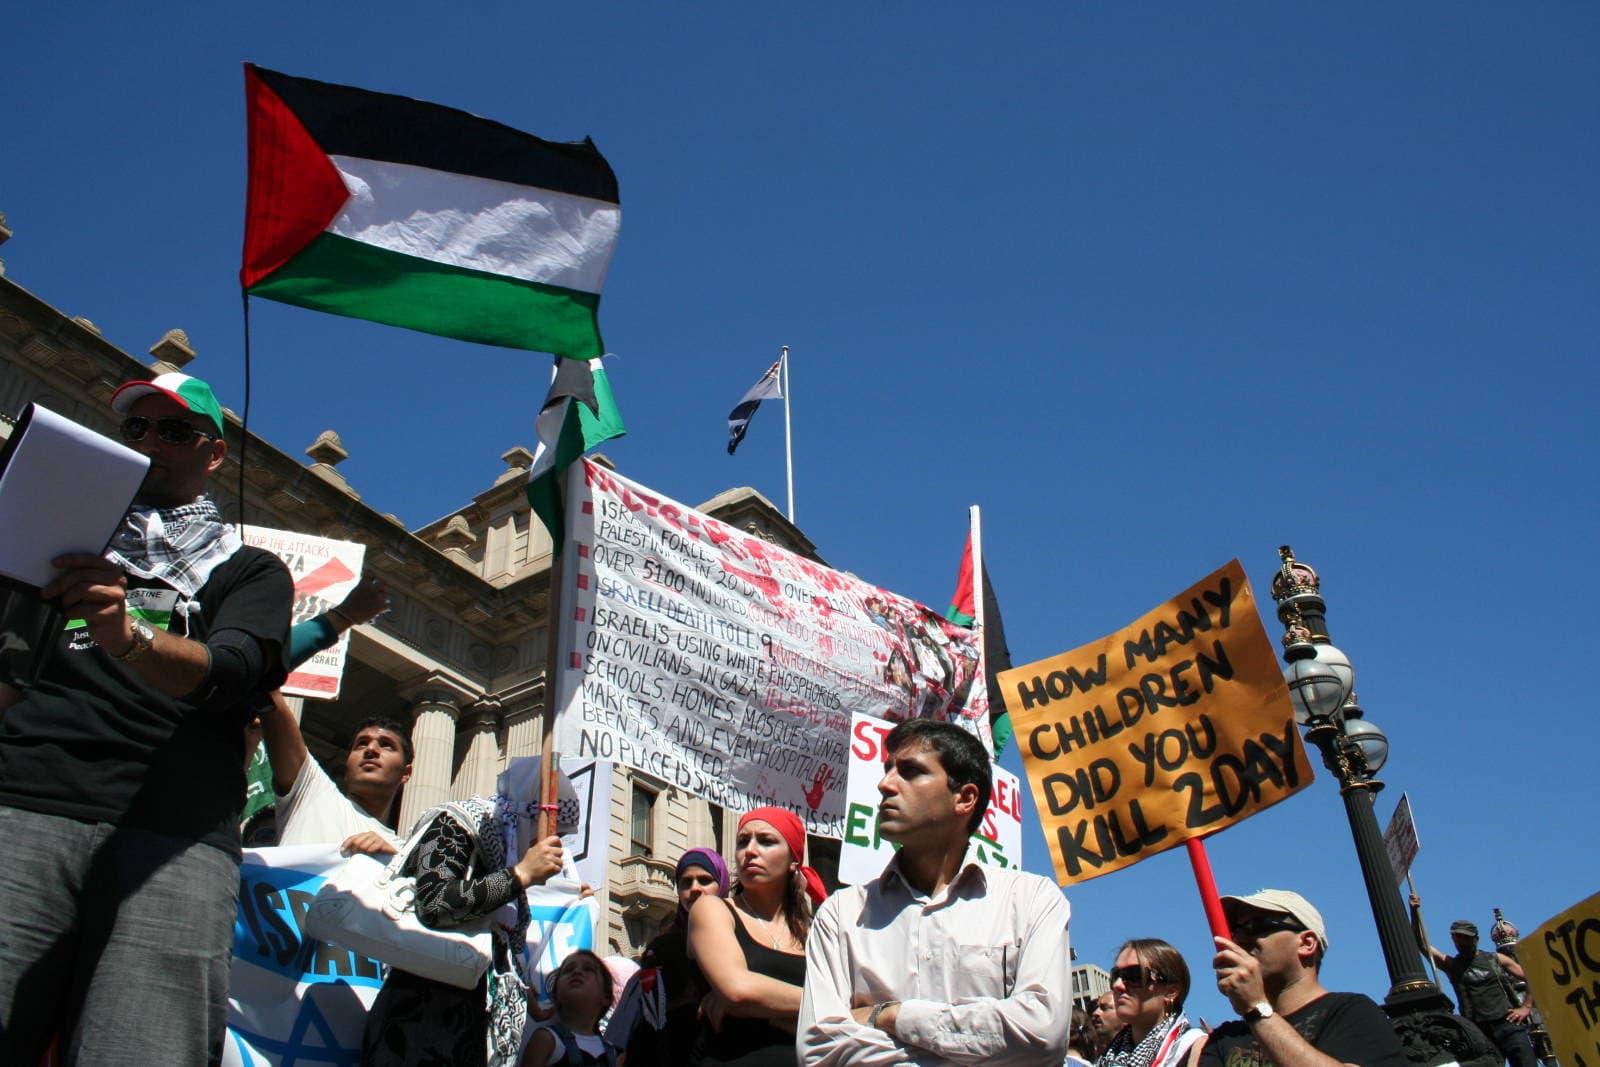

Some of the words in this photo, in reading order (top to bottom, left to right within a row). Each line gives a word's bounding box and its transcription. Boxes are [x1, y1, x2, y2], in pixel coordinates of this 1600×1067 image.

[268, 537, 286, 551] THE
[287, 541, 331, 558] ATTACKS
[593, 544, 636, 577] OVER
[642, 559, 686, 593] 5100
[715, 570, 738, 591] 20
[595, 577, 663, 614] ISRAELI
[666, 599, 714, 635] DEATH
[312, 654, 339, 667] ISRAEL
[586, 630, 611, 653] ON
[612, 638, 692, 675] CIVILIANS
[700, 663, 717, 685] IN
[719, 671, 758, 700] GAZA
[677, 631, 722, 661] USING
[726, 647, 766, 681] WHITE
[768, 663, 842, 710] PHOSPHORUS
[1017, 653, 1107, 711] HOW
[1124, 576, 1232, 670] MANY
[582, 702, 629, 735] BEEN
[582, 680, 660, 731] MARKETS
[664, 714, 706, 747] AND
[711, 727, 758, 763] EVEN
[1029, 639, 1235, 761] CHILDREN
[580, 729, 613, 758] NO
[619, 736, 672, 781] PLACE
[675, 759, 691, 788] IS
[805, 807, 819, 834] IS
[1042, 757, 1121, 817] DID
[1128, 713, 1217, 788] YOU
[1056, 798, 1168, 877] KILL
[1172, 718, 1299, 829] 2DAY
[1544, 918, 1600, 987] STO
